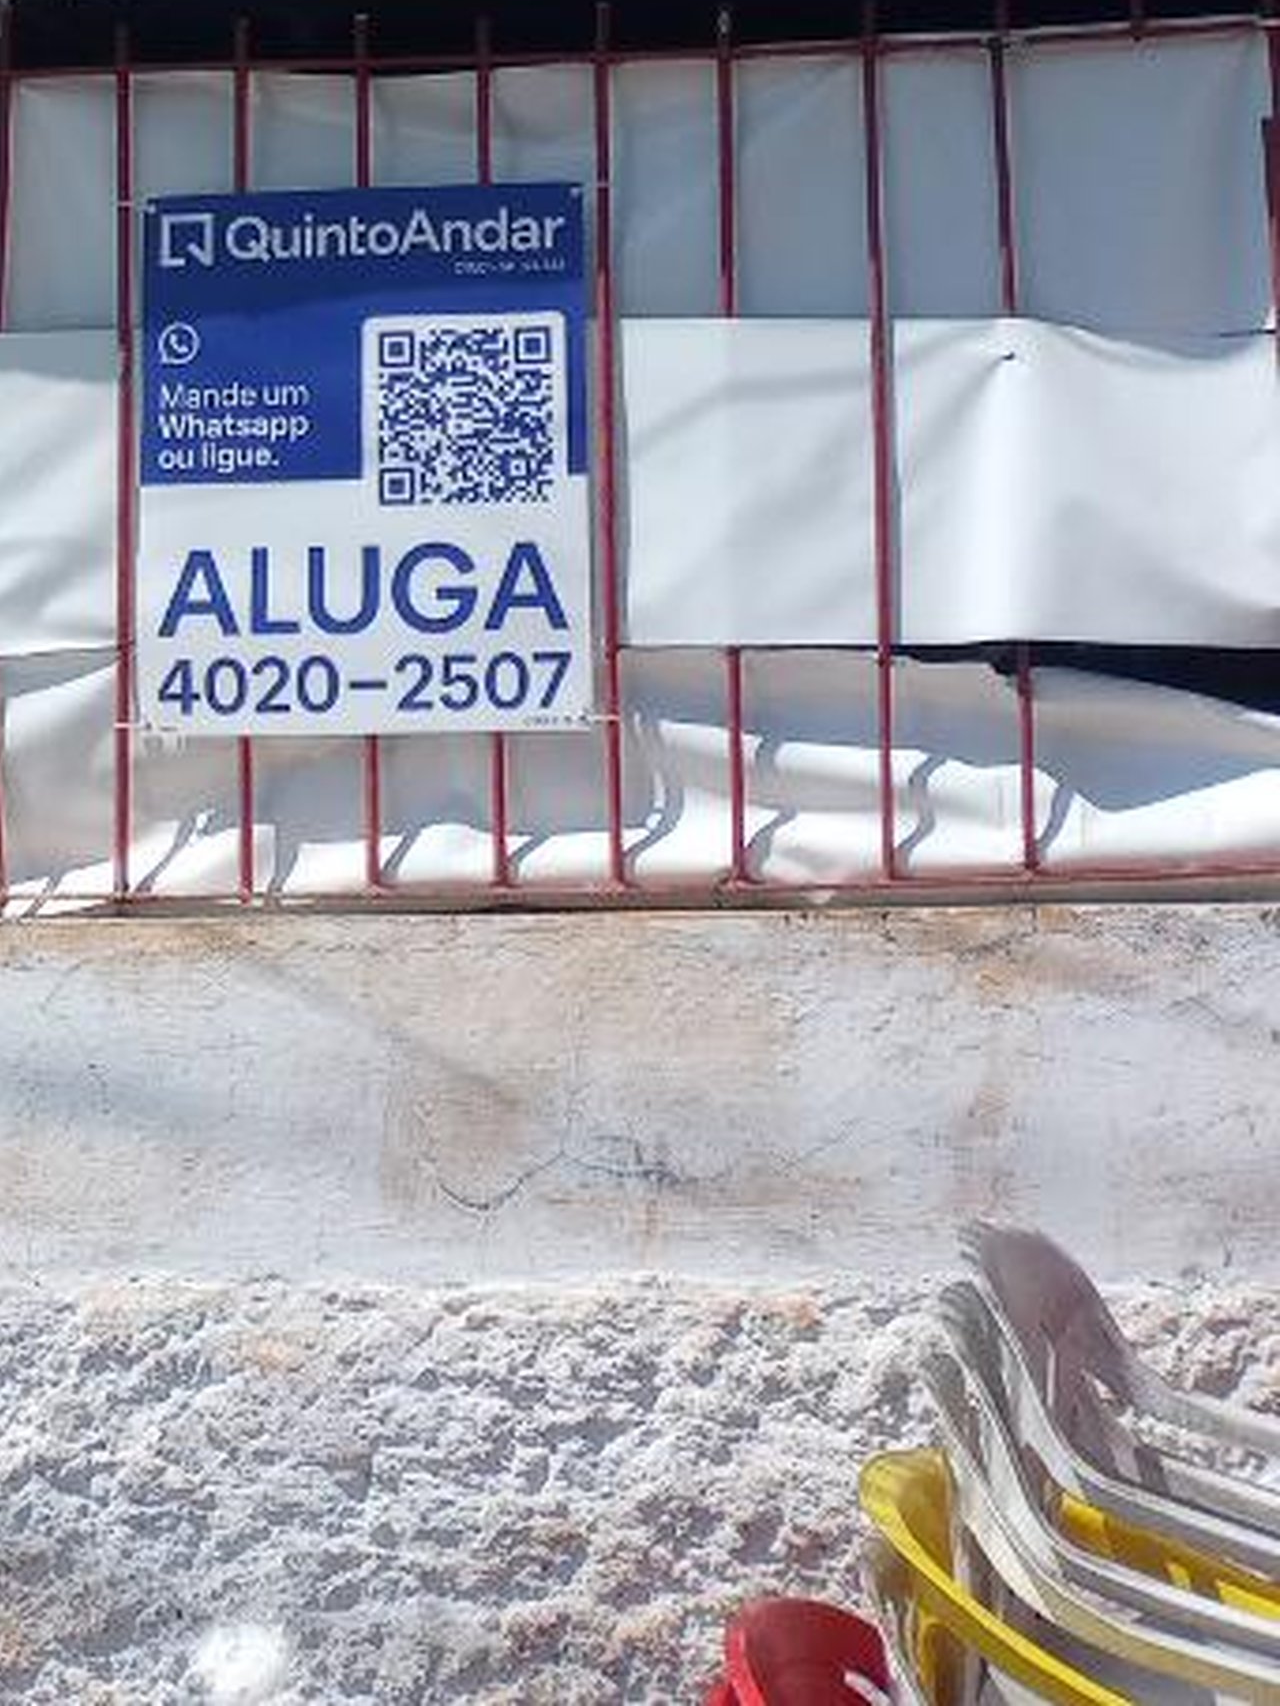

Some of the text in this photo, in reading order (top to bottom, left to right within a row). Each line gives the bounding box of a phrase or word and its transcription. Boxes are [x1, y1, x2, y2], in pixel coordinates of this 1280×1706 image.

[225, 207, 565, 262] QuintoAndar
[160, 381, 310, 409] Mande um
[158, 412, 309, 444] Whatsapp
[158, 441, 280, 474] ou ligue.
[158, 541, 569, 637] ALUGA
[156, 651, 572, 715] 4020-2507
